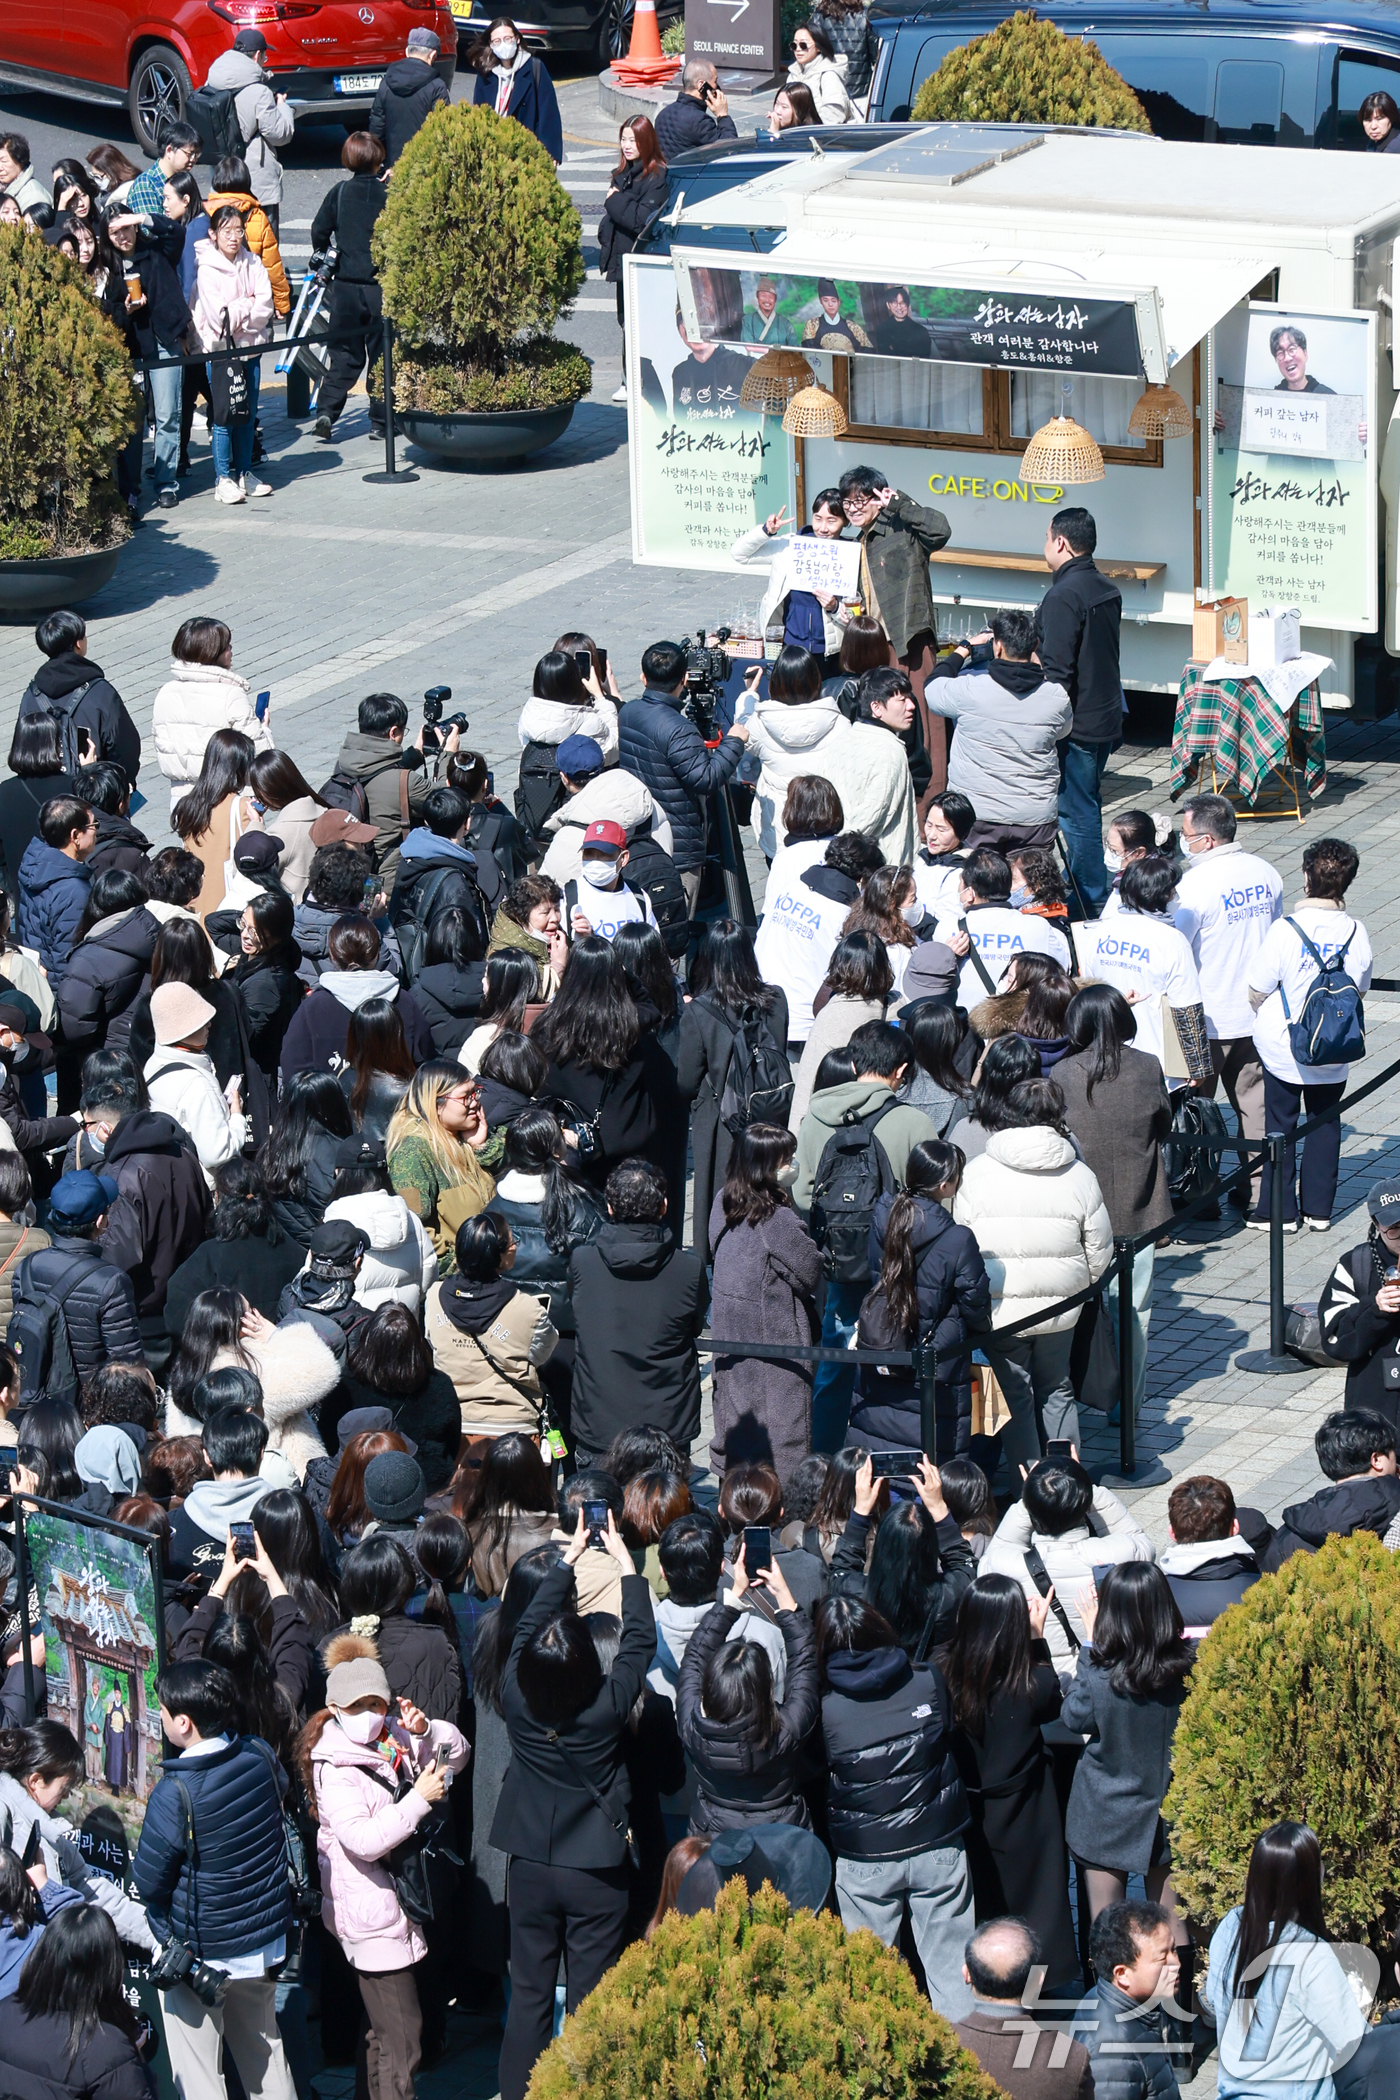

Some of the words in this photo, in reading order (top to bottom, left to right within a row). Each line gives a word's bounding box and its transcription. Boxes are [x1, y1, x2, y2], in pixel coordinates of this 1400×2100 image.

[693, 40, 713, 53] SEOUL
[713, 41, 739, 55] FINANCE
[740, 44, 764, 56] CENTER
[343, 76, 369, 90] 184도
[970, 331, 994, 346] 관객
[998, 334, 1034, 350] 여러분
[1038, 337, 1099, 355] 감사합니다
[1254, 406, 1273, 419] 커피
[1299, 410, 1319, 423] 남자
[660, 466, 718, 481] 사랑해주시는
[721, 470, 768, 486] 관객분들께
[674, 483, 703, 496] 감사의
[706, 485, 734, 498] 마음을
[738, 488, 756, 500] 담아
[928, 473, 1028, 502] CAFE:ON
[684, 499, 712, 512] 커피를
[716, 501, 747, 515] 쏩니다!
[684, 524, 710, 535] 관객과
[714, 525, 731, 537] 사는
[1233, 514, 1293, 531] 사랑해주시는
[1296, 520, 1346, 536] 관객분들께
[1247, 532, 1277, 545] 감사의
[1280, 535, 1310, 549] 마음을
[1314, 538, 1333, 550] 담아
[1256, 549, 1286, 563] 커피를
[1289, 552, 1324, 566] 쏩니다!
[1256, 574, 1283, 587] 관객과
[1286, 576, 1304, 588] 사는
[1307, 579, 1325, 591] 남자
[1221, 883, 1273, 911] KOFPA
[773, 891, 822, 931] KOFPA
[1096, 935, 1150, 963] KOFPA
[97, 1838, 124, 1865] 사는
